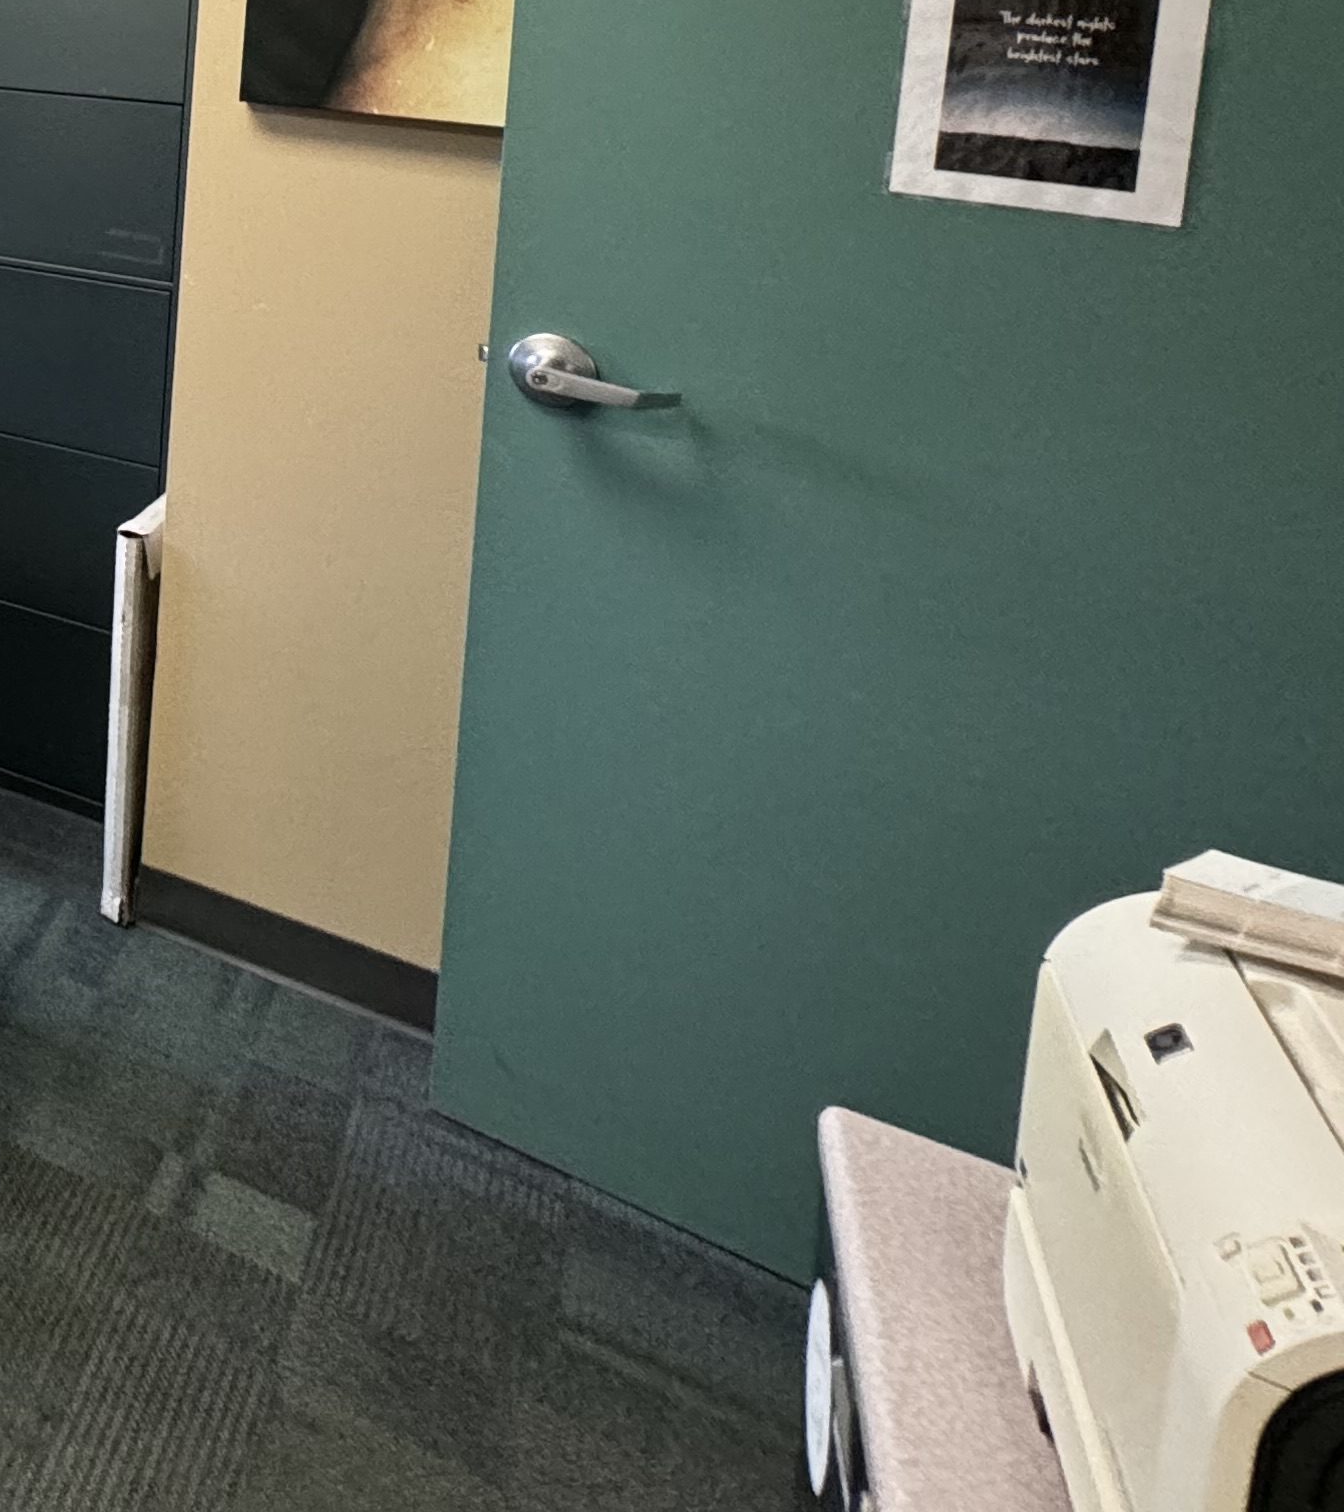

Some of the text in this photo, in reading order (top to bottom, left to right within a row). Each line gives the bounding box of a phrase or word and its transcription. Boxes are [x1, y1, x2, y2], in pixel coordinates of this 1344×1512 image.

[999, 10, 1116, 32] The darkest nights
[1017, 30, 1093, 47] produce the
[1007, 46, 1100, 66] brightest stars
